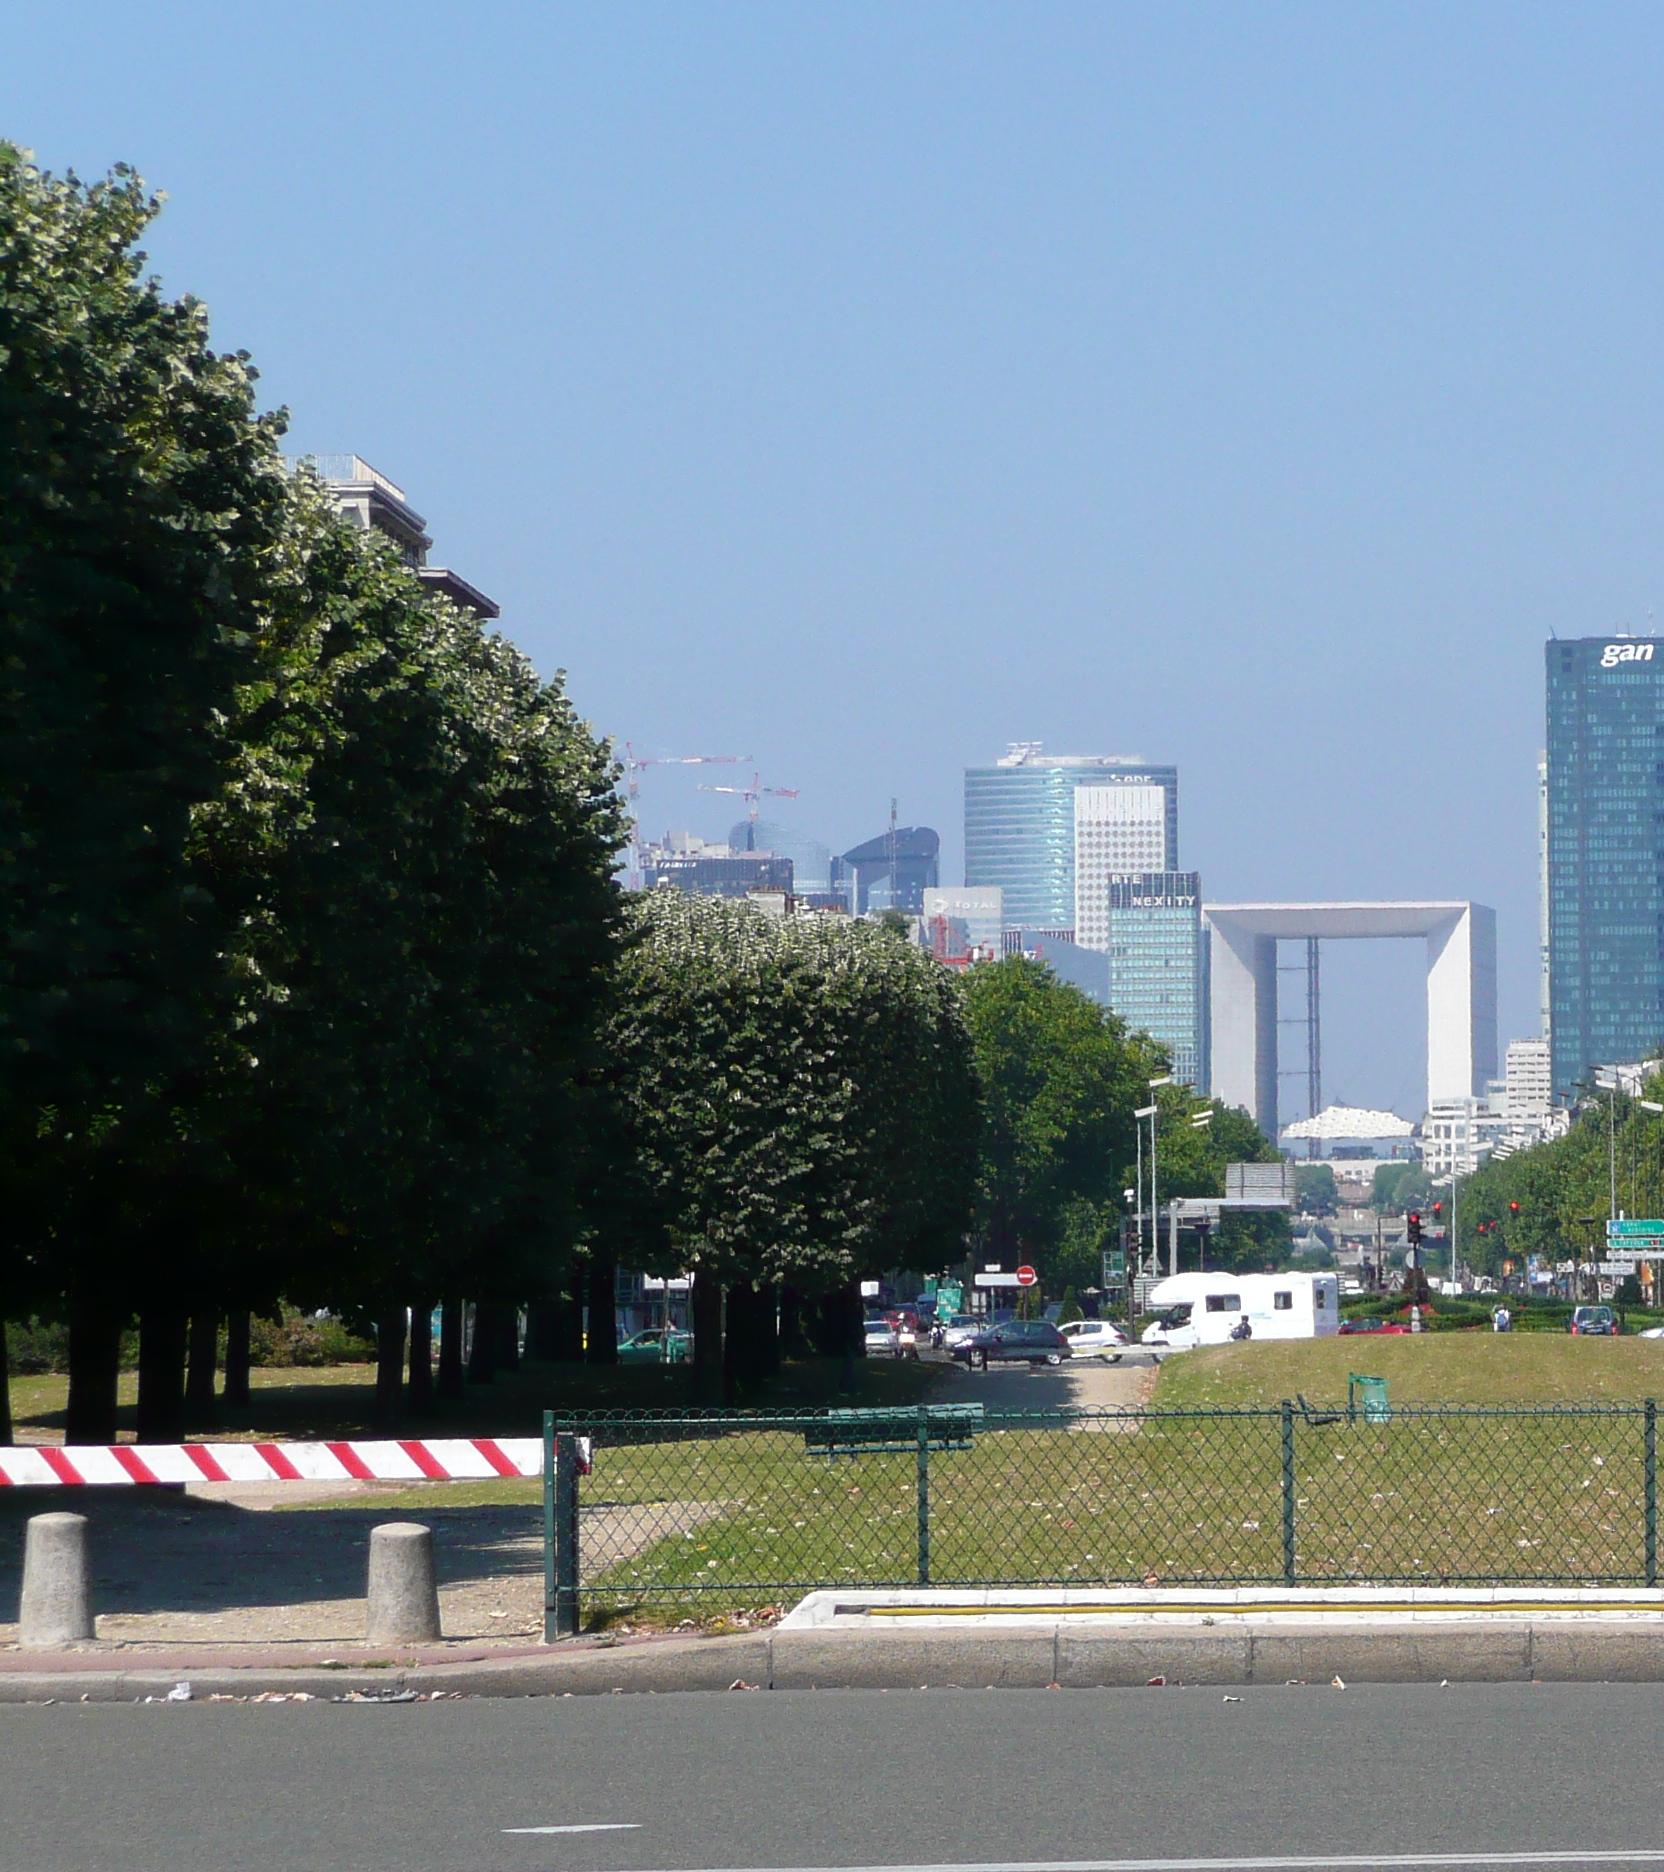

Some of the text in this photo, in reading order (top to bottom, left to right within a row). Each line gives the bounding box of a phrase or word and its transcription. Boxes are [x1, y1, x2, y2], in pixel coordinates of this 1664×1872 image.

[1600, 643, 1655, 668] gan
[1111, 874, 1142, 884] RTE
[953, 900, 998, 909] TOTAL
